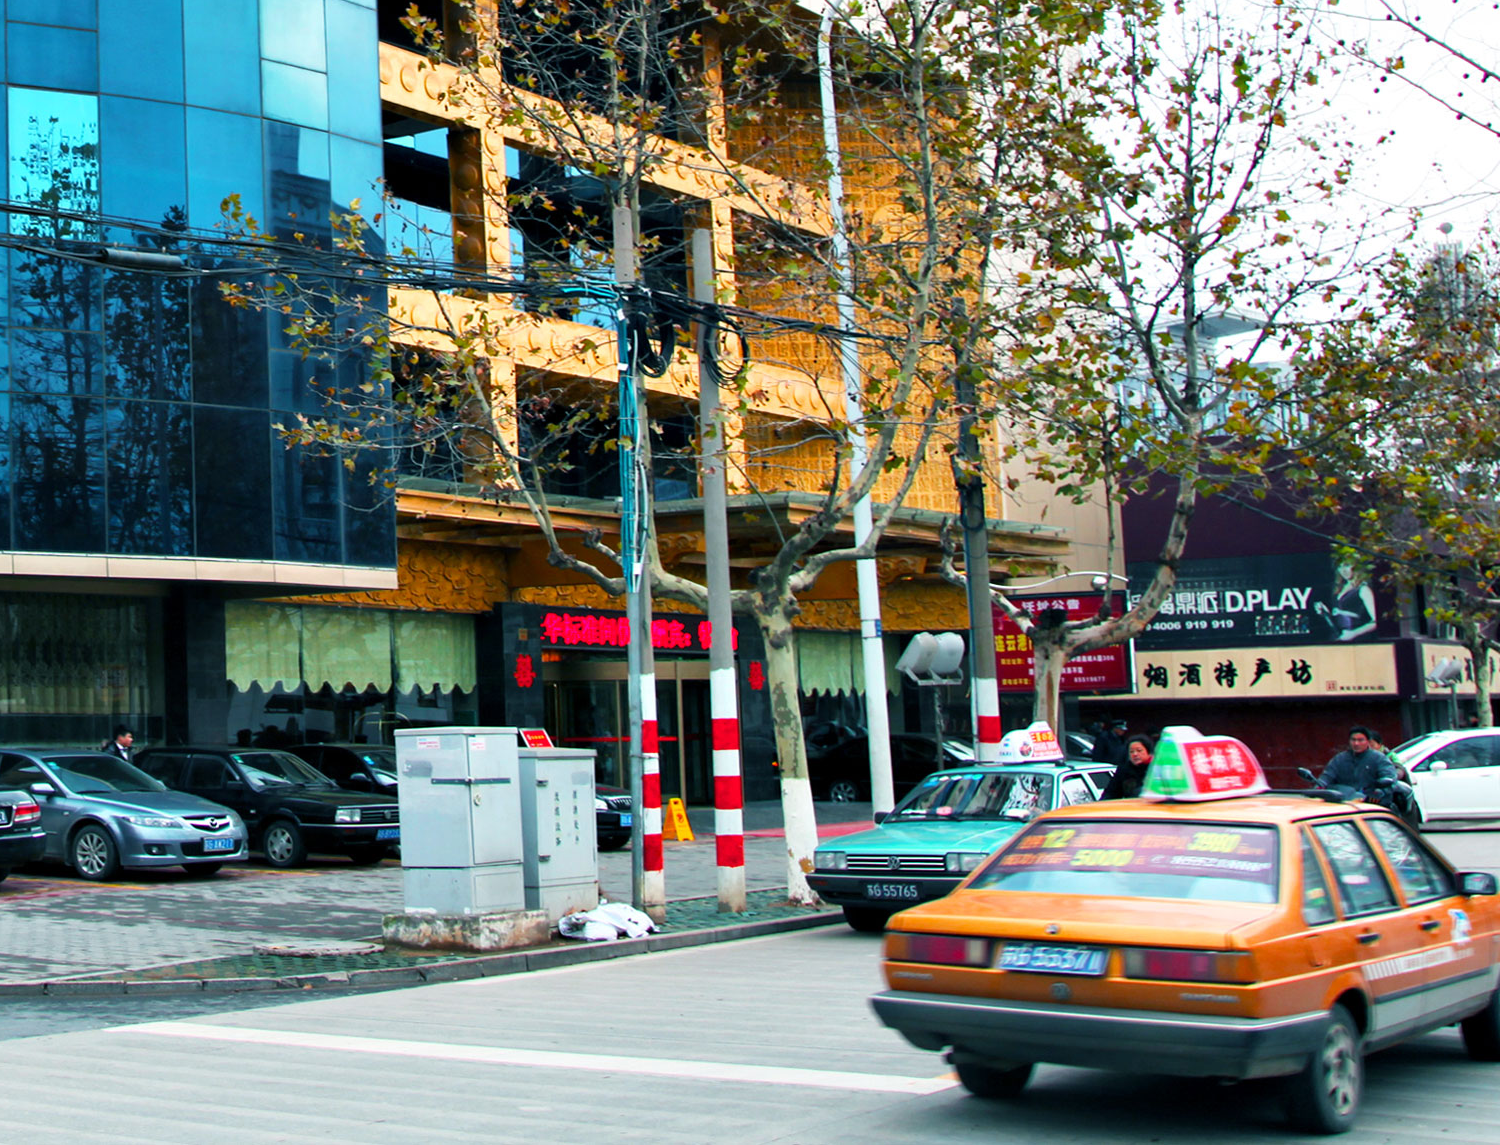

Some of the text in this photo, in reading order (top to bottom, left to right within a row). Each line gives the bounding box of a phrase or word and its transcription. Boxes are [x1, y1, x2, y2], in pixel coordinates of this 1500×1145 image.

[1224, 586, 1313, 613] D.PLAY
[1152, 619, 1234, 631] 4006 919 919
[1143, 657, 1314, 689] 烟酒特产坊
